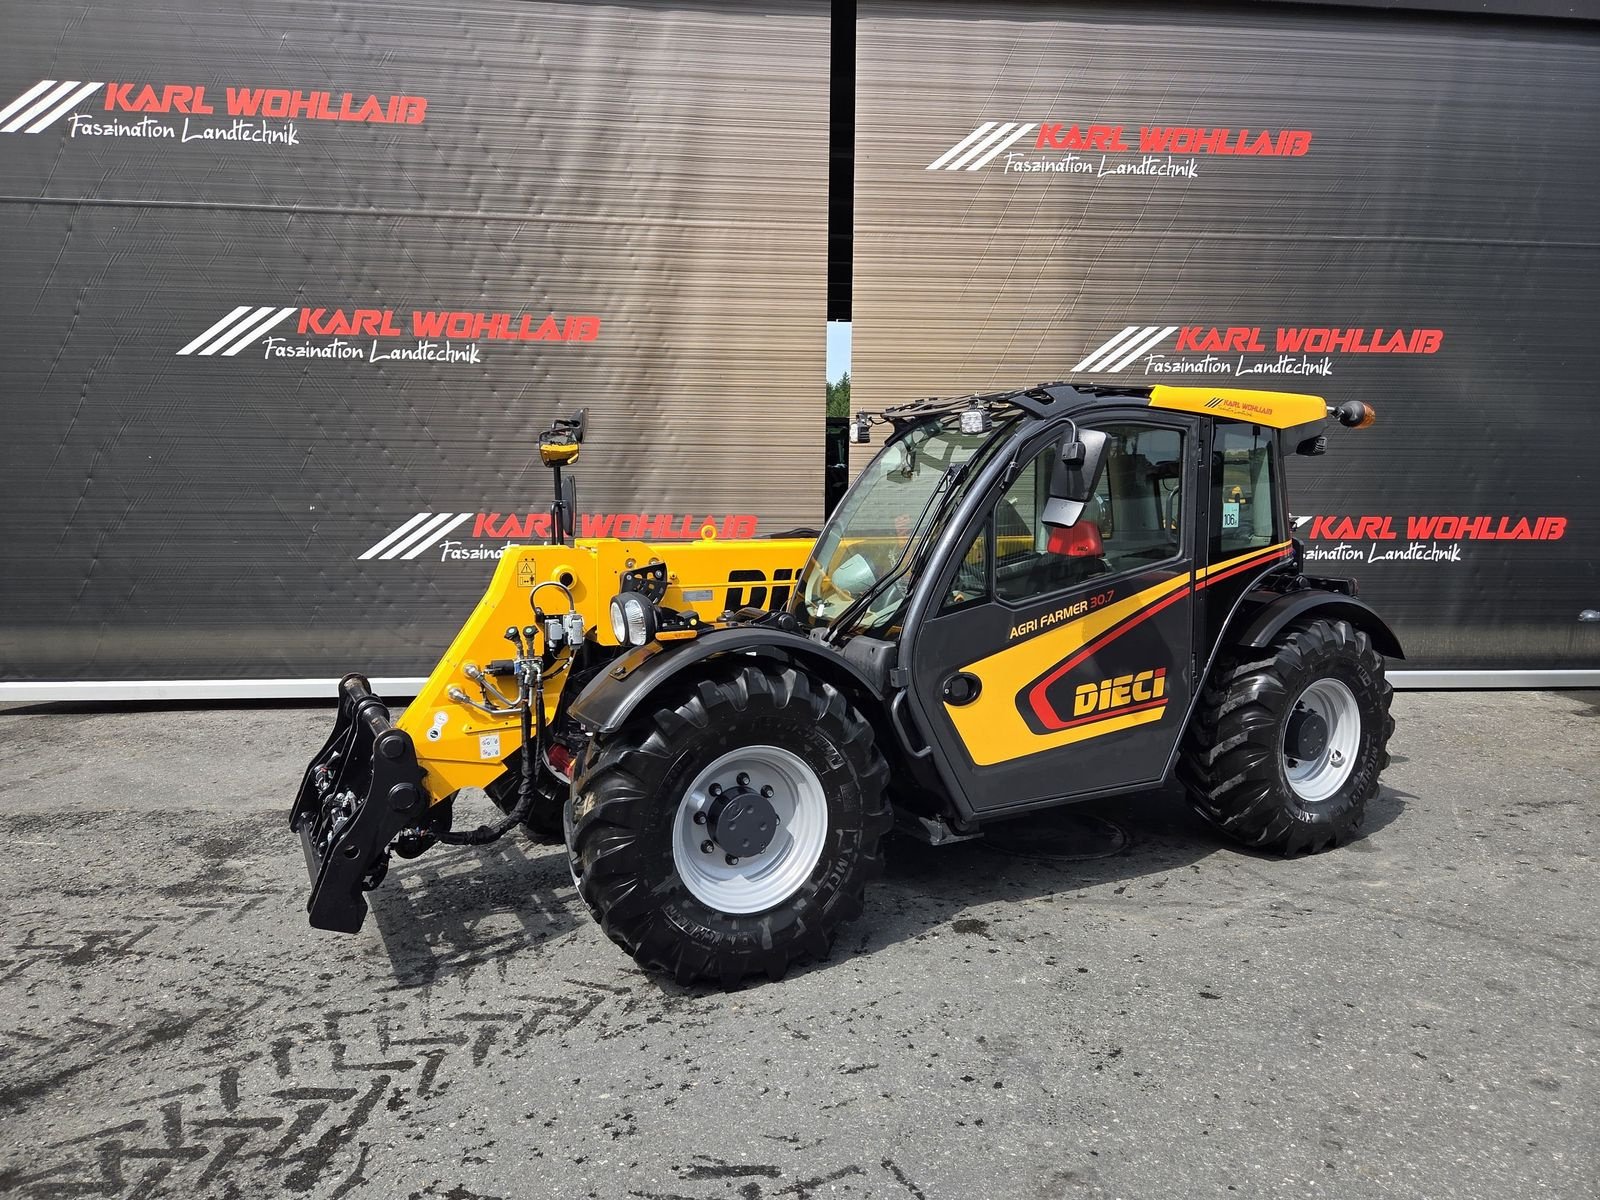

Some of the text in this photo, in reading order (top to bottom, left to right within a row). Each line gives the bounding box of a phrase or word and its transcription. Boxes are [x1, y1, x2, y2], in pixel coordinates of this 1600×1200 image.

[105, 83, 213, 115] KARL
[68, 113, 299, 145] Faszination Landtechnik
[1035, 123, 1129, 152] KARL
[1003, 151, 1198, 178] Faszination Landtechnik
[297, 308, 400, 336] KARL
[262, 336, 481, 364] Faszination Landtechnik
[1175, 327, 1265, 353] KARL
[1144, 354, 1333, 377] Faszination Landtechnik
[1224, 400, 1240, 409] KARL
[1225, 513, 1235, 526] 106
[1309, 515, 1397, 540] KARL
[1302, 541, 1461, 563] zination Landtechnik
[1009, 589, 1115, 640] AGRI FARMER 30.7
[1073, 667, 1167, 717] DIECI
